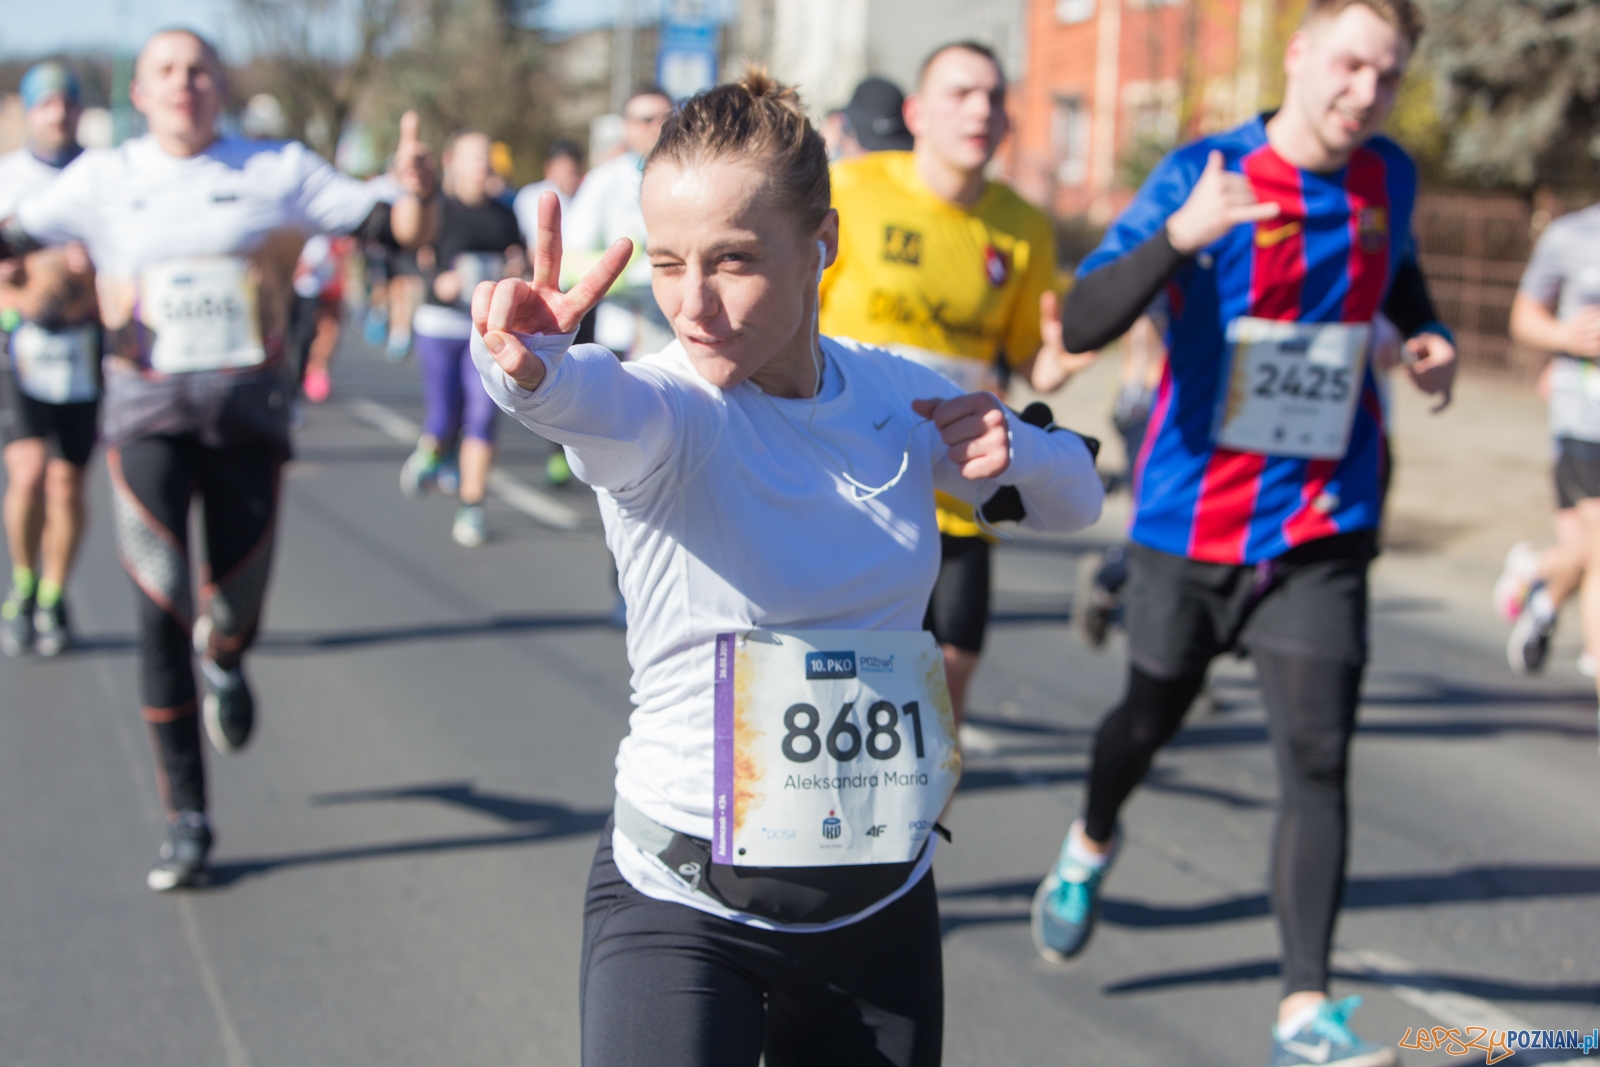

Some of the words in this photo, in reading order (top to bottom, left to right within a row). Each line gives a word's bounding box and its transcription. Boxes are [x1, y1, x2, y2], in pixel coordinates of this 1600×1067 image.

[1254, 362, 1351, 402] 2425
[810, 659, 826, 672] 10.
[827, 658, 852, 672] PKO
[781, 700, 926, 763] 8681
[784, 772, 878, 790] Aleksandra
[884, 771, 929, 787] Maria
